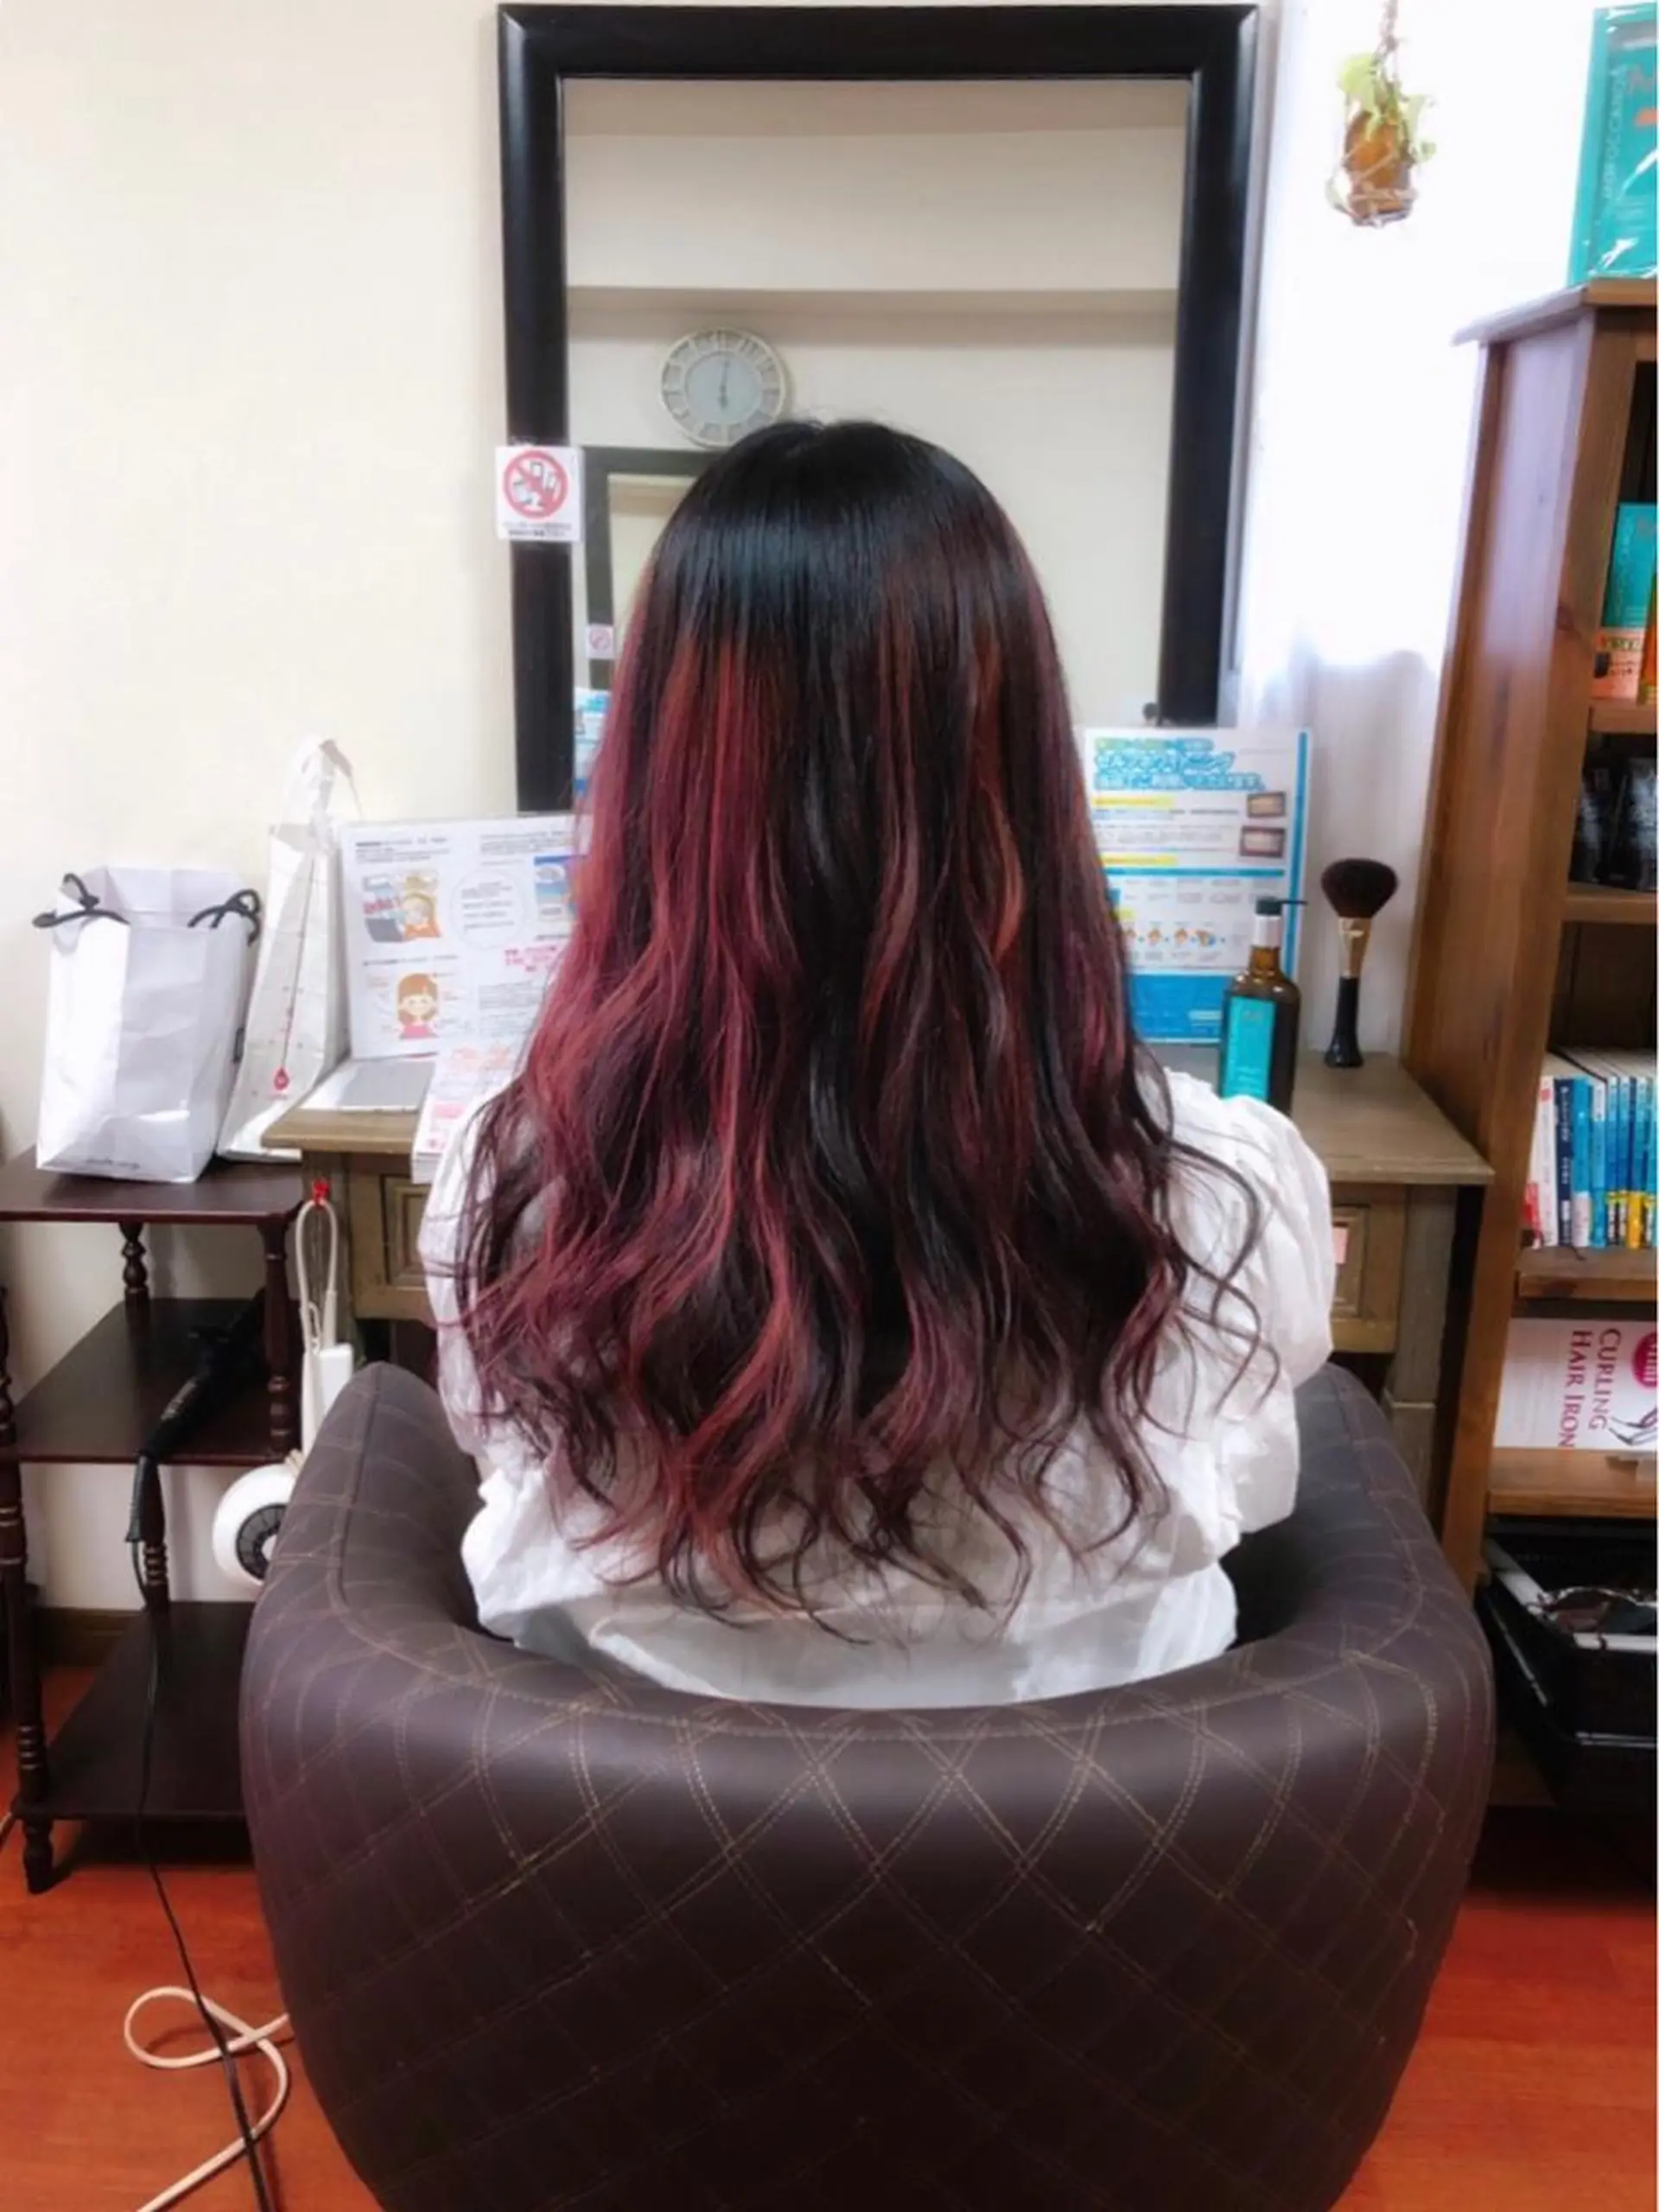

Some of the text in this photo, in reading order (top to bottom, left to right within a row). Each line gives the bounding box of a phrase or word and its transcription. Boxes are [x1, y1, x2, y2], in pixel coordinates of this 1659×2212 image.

[1559, 1330, 1592, 1447] HAIR IRON
[1589, 1328, 1622, 1430] CURLING
